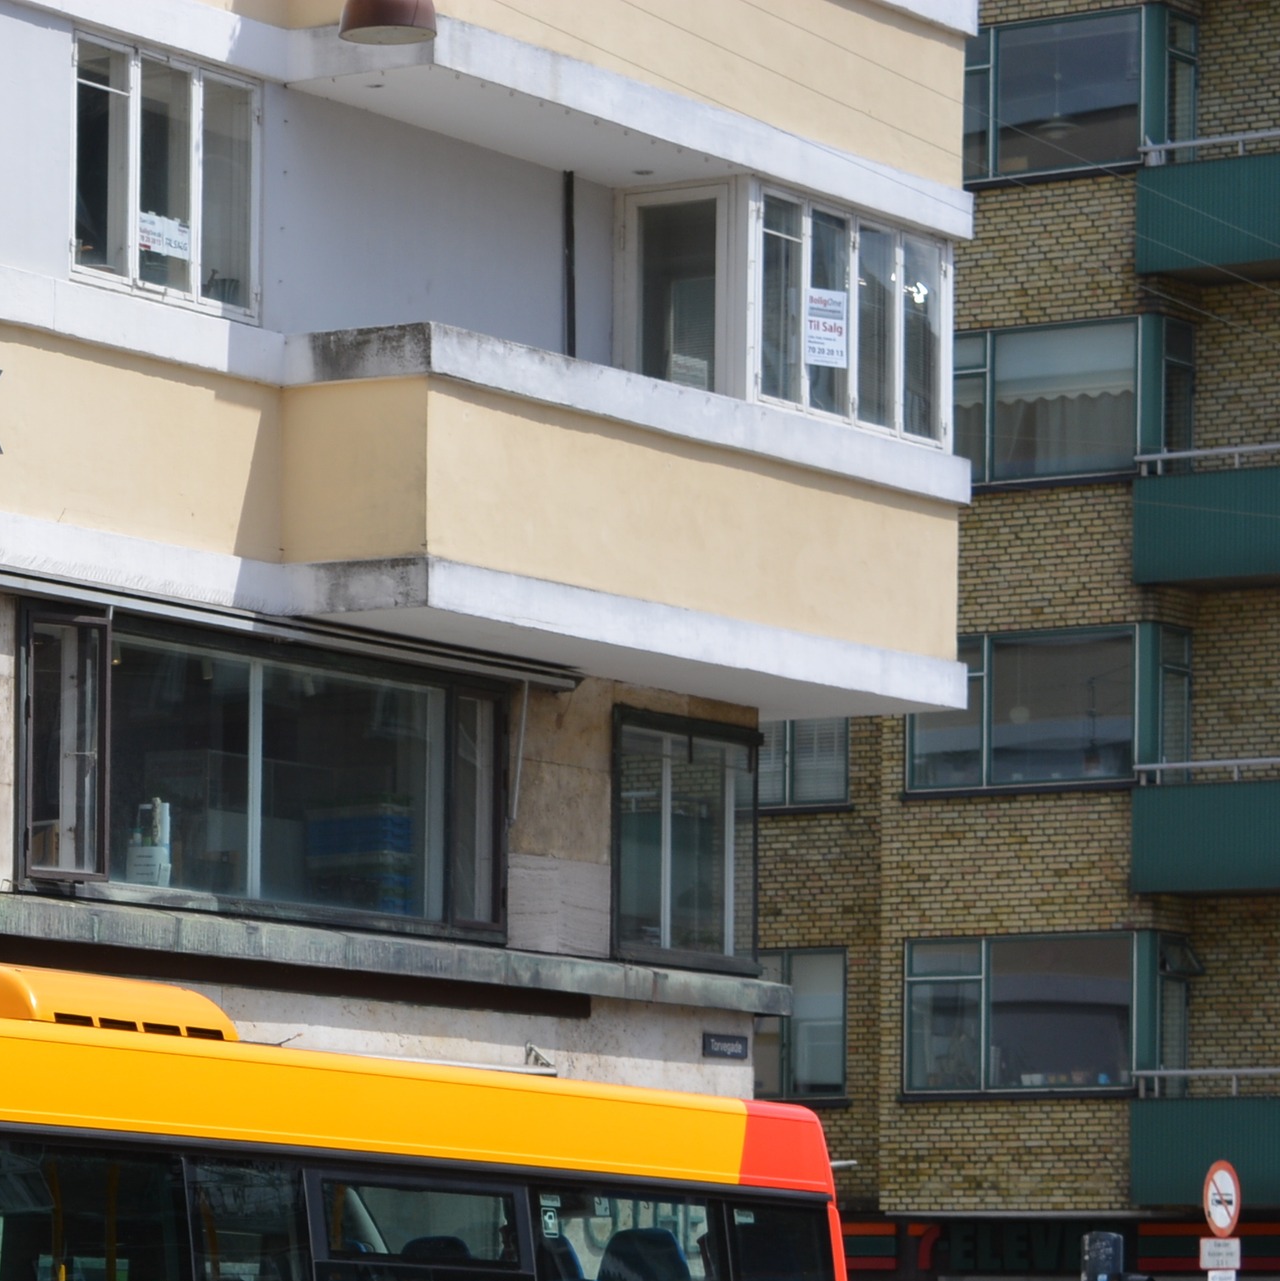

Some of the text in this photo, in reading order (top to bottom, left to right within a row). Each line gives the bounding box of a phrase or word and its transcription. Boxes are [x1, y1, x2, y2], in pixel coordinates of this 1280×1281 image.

[808, 320, 843, 337] Til Salg
[710, 1038, 743, 1055] Torvegade
